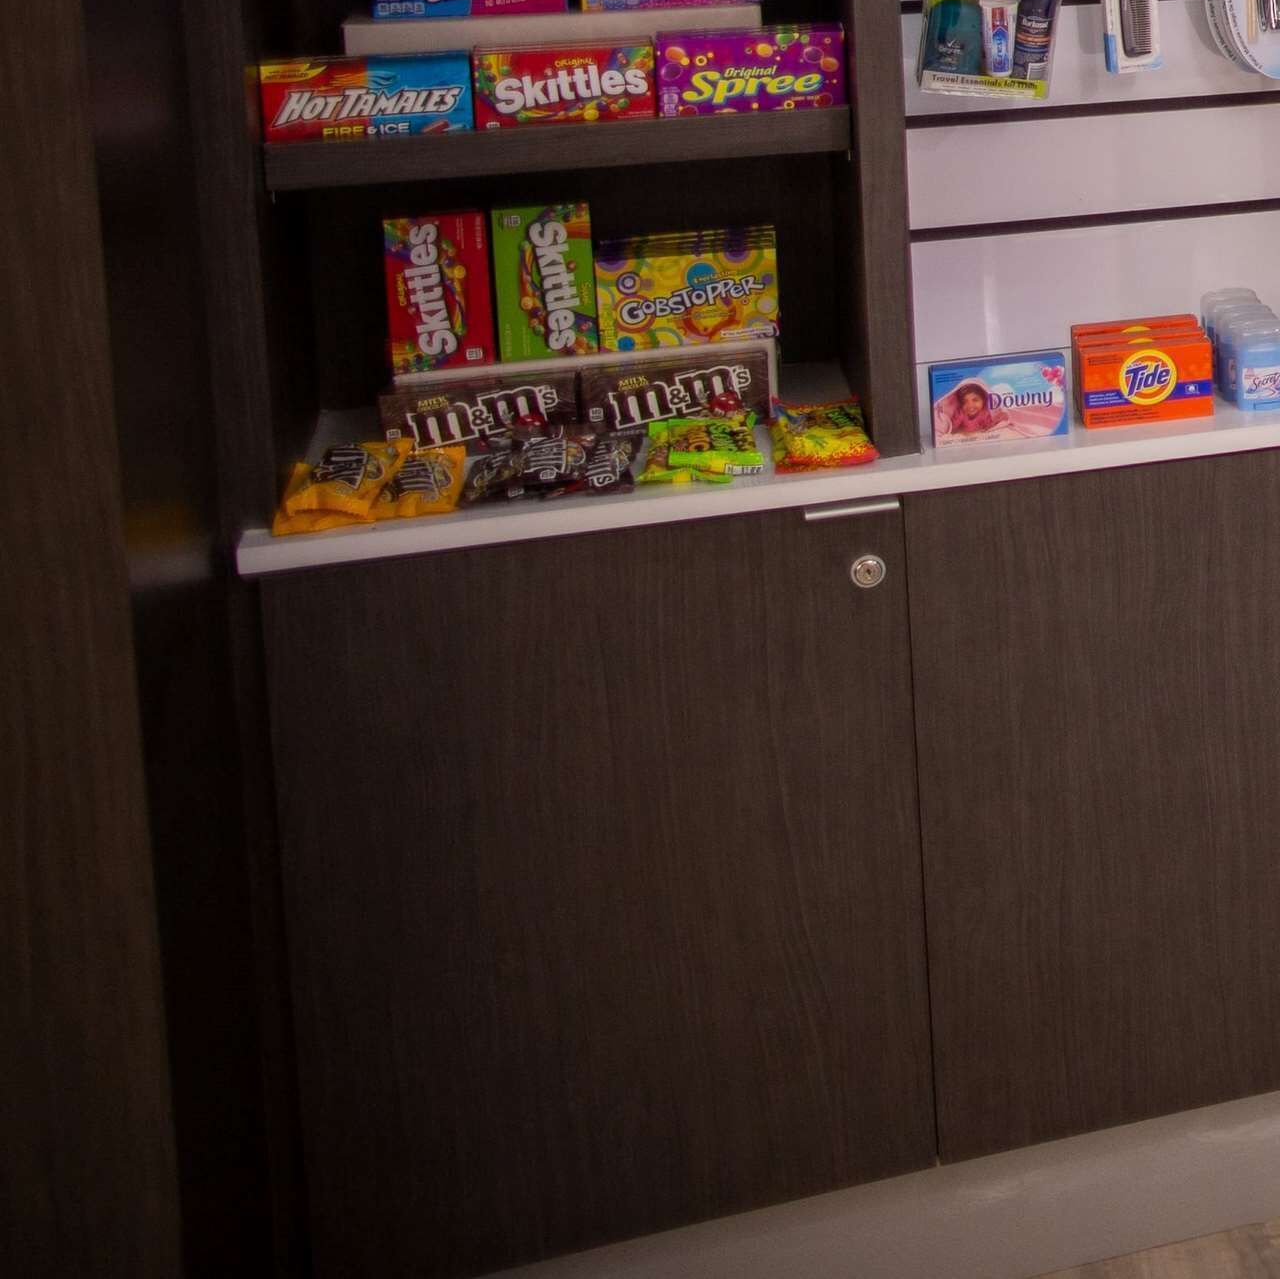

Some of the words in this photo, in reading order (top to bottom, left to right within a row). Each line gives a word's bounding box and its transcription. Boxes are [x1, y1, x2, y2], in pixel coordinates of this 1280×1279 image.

[723, 66, 777, 80] Original
[932, 74, 959, 84] Travel
[960, 76, 1001, 87] Essentials
[495, 64, 649, 115] Skittles
[682, 70, 824, 106] Spree
[379, 122, 411, 135] ICE
[404, 222, 458, 356] Skittles
[528, 221, 581, 351] Skittles
[1125, 363, 1171, 398] Tide
[1252, 372, 1280, 391] Secret
[987, 391, 1054, 411] Downy
